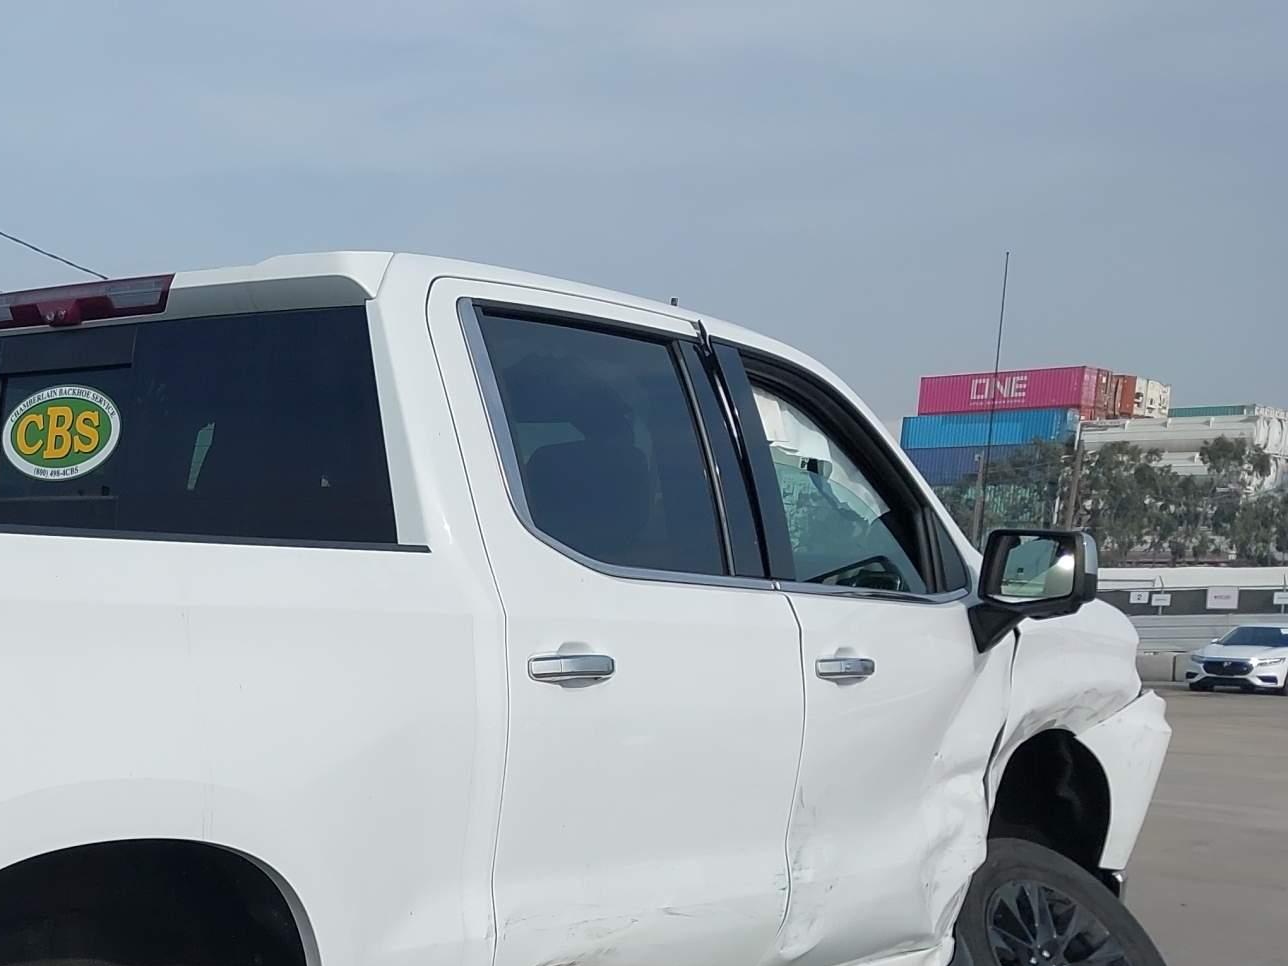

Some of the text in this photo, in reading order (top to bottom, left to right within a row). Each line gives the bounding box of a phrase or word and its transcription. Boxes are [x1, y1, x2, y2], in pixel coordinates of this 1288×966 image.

[971, 376, 1027, 399] ONE
[11, 388, 116, 422] CHAMBERLAIN BACKHOE SERVICE
[16, 406, 101, 459] CBS
